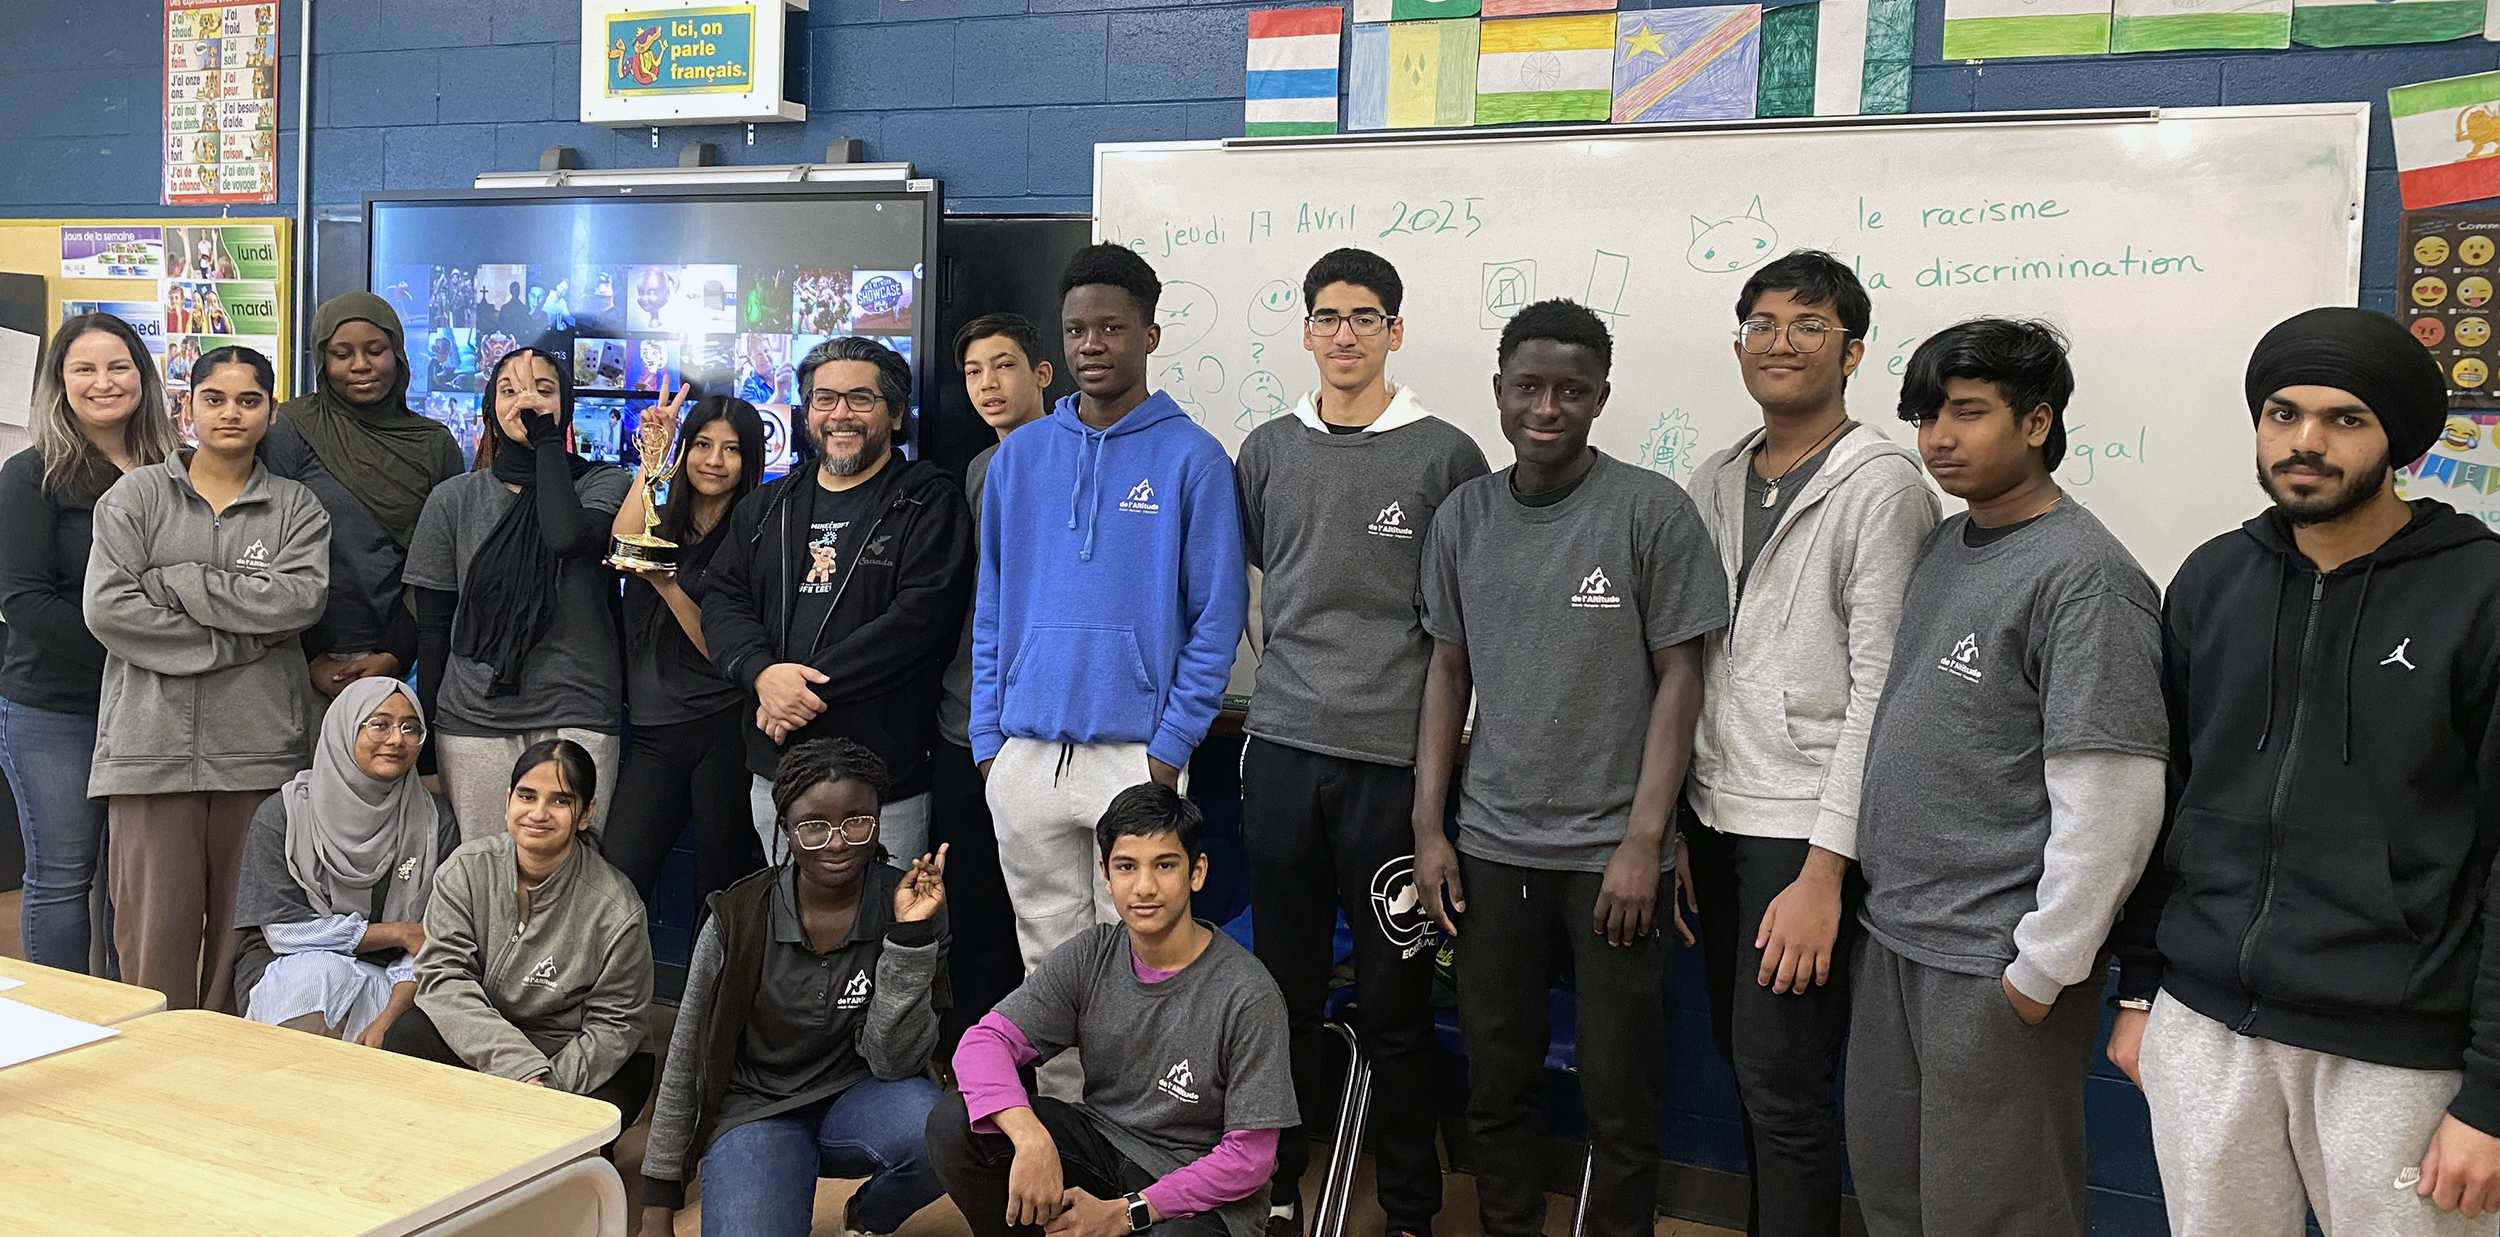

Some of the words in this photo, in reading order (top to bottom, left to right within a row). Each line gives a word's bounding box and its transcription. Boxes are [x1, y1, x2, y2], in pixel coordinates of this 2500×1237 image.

[172, 12, 184, 25] J'ai
[225, 8, 237, 21] J'ai
[172, 26, 193, 38] chaud.
[225, 22, 242, 34] froid.
[672, 20, 698, 39] Ici,
[701, 22, 722, 36] on
[172, 43, 184, 55] J'ai
[224, 39, 237, 52] J'ai
[671, 40, 716, 61] parle
[172, 57, 188, 69] faim.
[224, 53, 239, 66] soif.
[223, 71, 236, 84] J'ai
[671, 60, 747, 83] français.
[171, 74, 184, 86] J'ai
[185, 76, 201, 86] onze
[171, 89, 185, 99] ans.
[223, 85, 241, 99] peur.
[171, 105, 184, 117] J'ai
[185, 104, 197, 116] mal
[223, 102, 236, 114] J'ai
[238, 101, 259, 114] besoin
[171, 120, 183, 131] aux
[171, 136, 183, 148] J'ai
[223, 134, 236, 146] J'ai
[171, 167, 183, 178] J'ai
[184, 166, 192, 178] de
[223, 165, 235, 177] J'ai
[237, 164, 255, 176] envie
[171, 180, 178, 192] la
[223, 179, 231, 191] de
[1859, 196, 1884, 231] le
[1922, 199, 2070, 229] racisme
[1162, 215, 1226, 257] jeudi
[1250, 211, 1272, 242] 17
[1298, 202, 1354, 234] Avril
[1379, 197, 1484, 239] 2025
[64, 231, 82, 241] Jours
[84, 231, 93, 241] de
[95, 231, 102, 241] la
[104, 231, 135, 241] semaine
[238, 244, 272, 261] lundi
[1915, 245, 2204, 288] discrimination
[858, 283, 901, 305] SHOWCASE
[232, 301, 272, 316] mardi
[2064, 423, 2146, 486] gal
[858, 557, 894, 567] Canada
